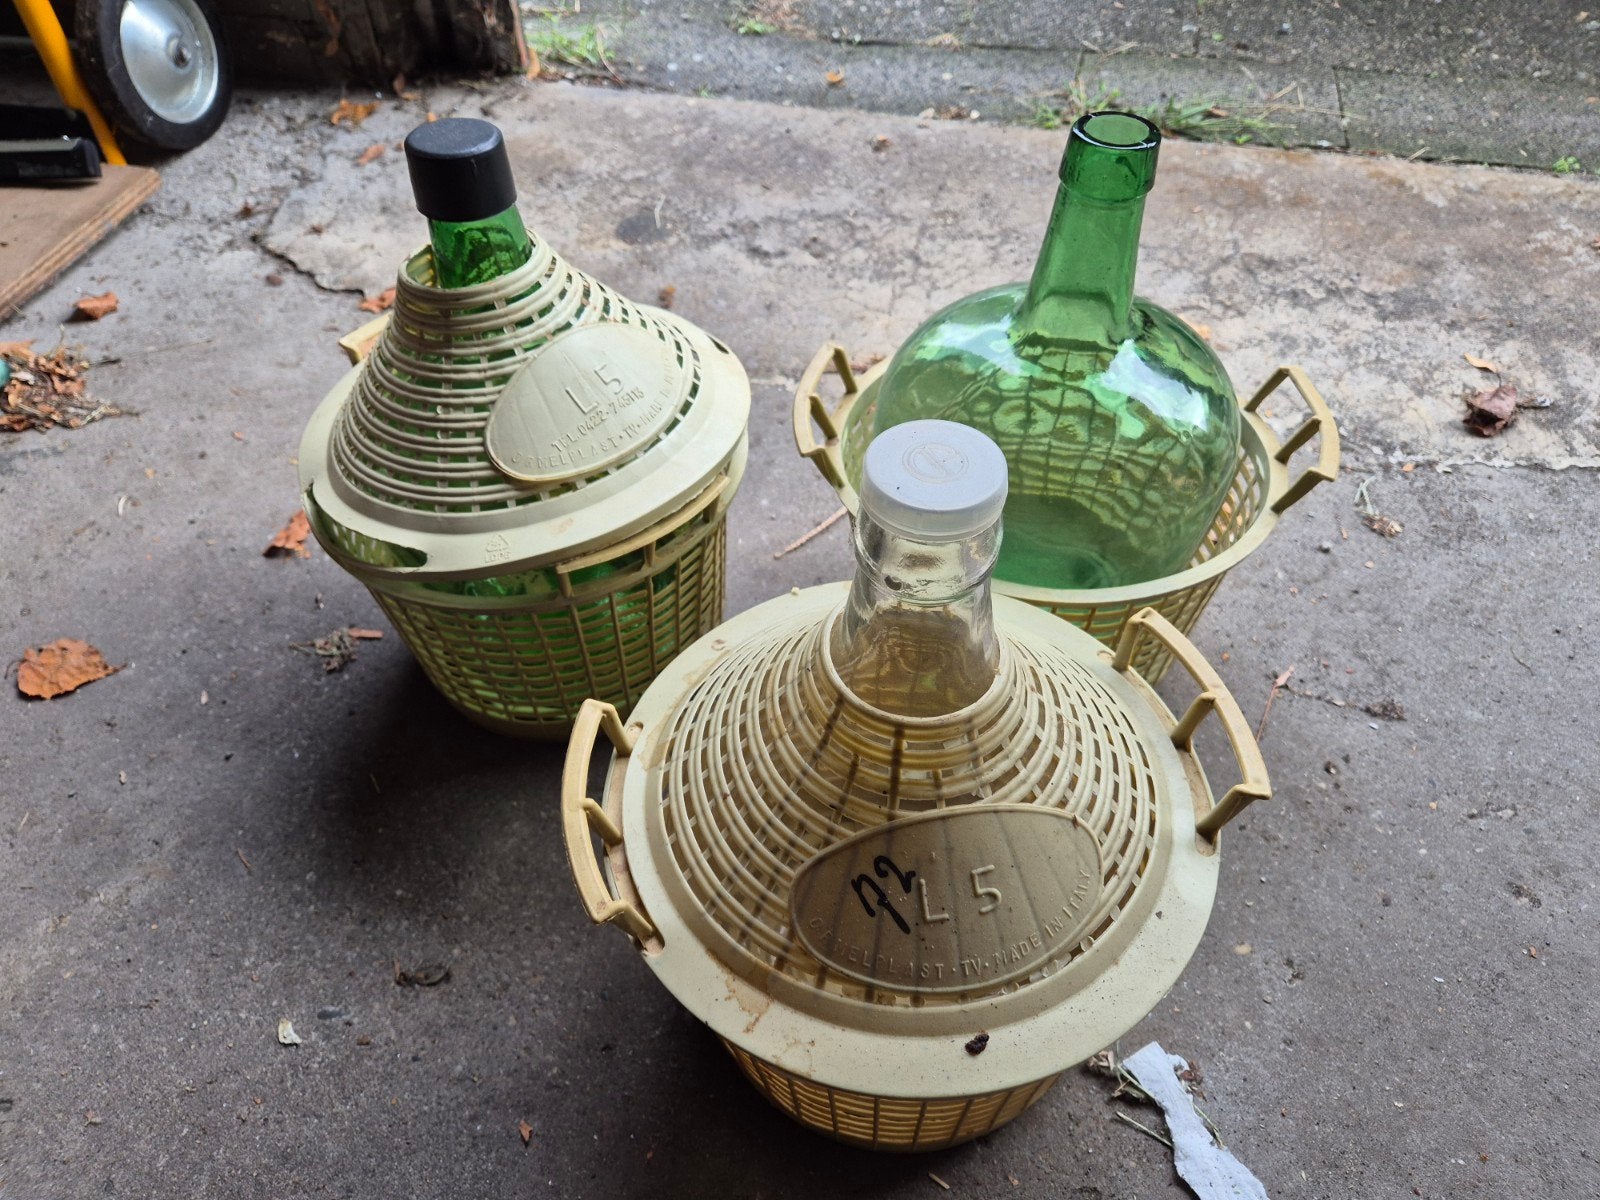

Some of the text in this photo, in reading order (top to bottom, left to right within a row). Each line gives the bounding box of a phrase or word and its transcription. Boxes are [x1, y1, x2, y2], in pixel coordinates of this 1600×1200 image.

[565, 386, 600, 415] L
[594, 362, 625, 396] 5
[917, 863, 1003, 924] L 5
[993, 934, 1042, 967] MADE
[1044, 915, 1065, 938] IN
[1063, 869, 1092, 919] ITALY
